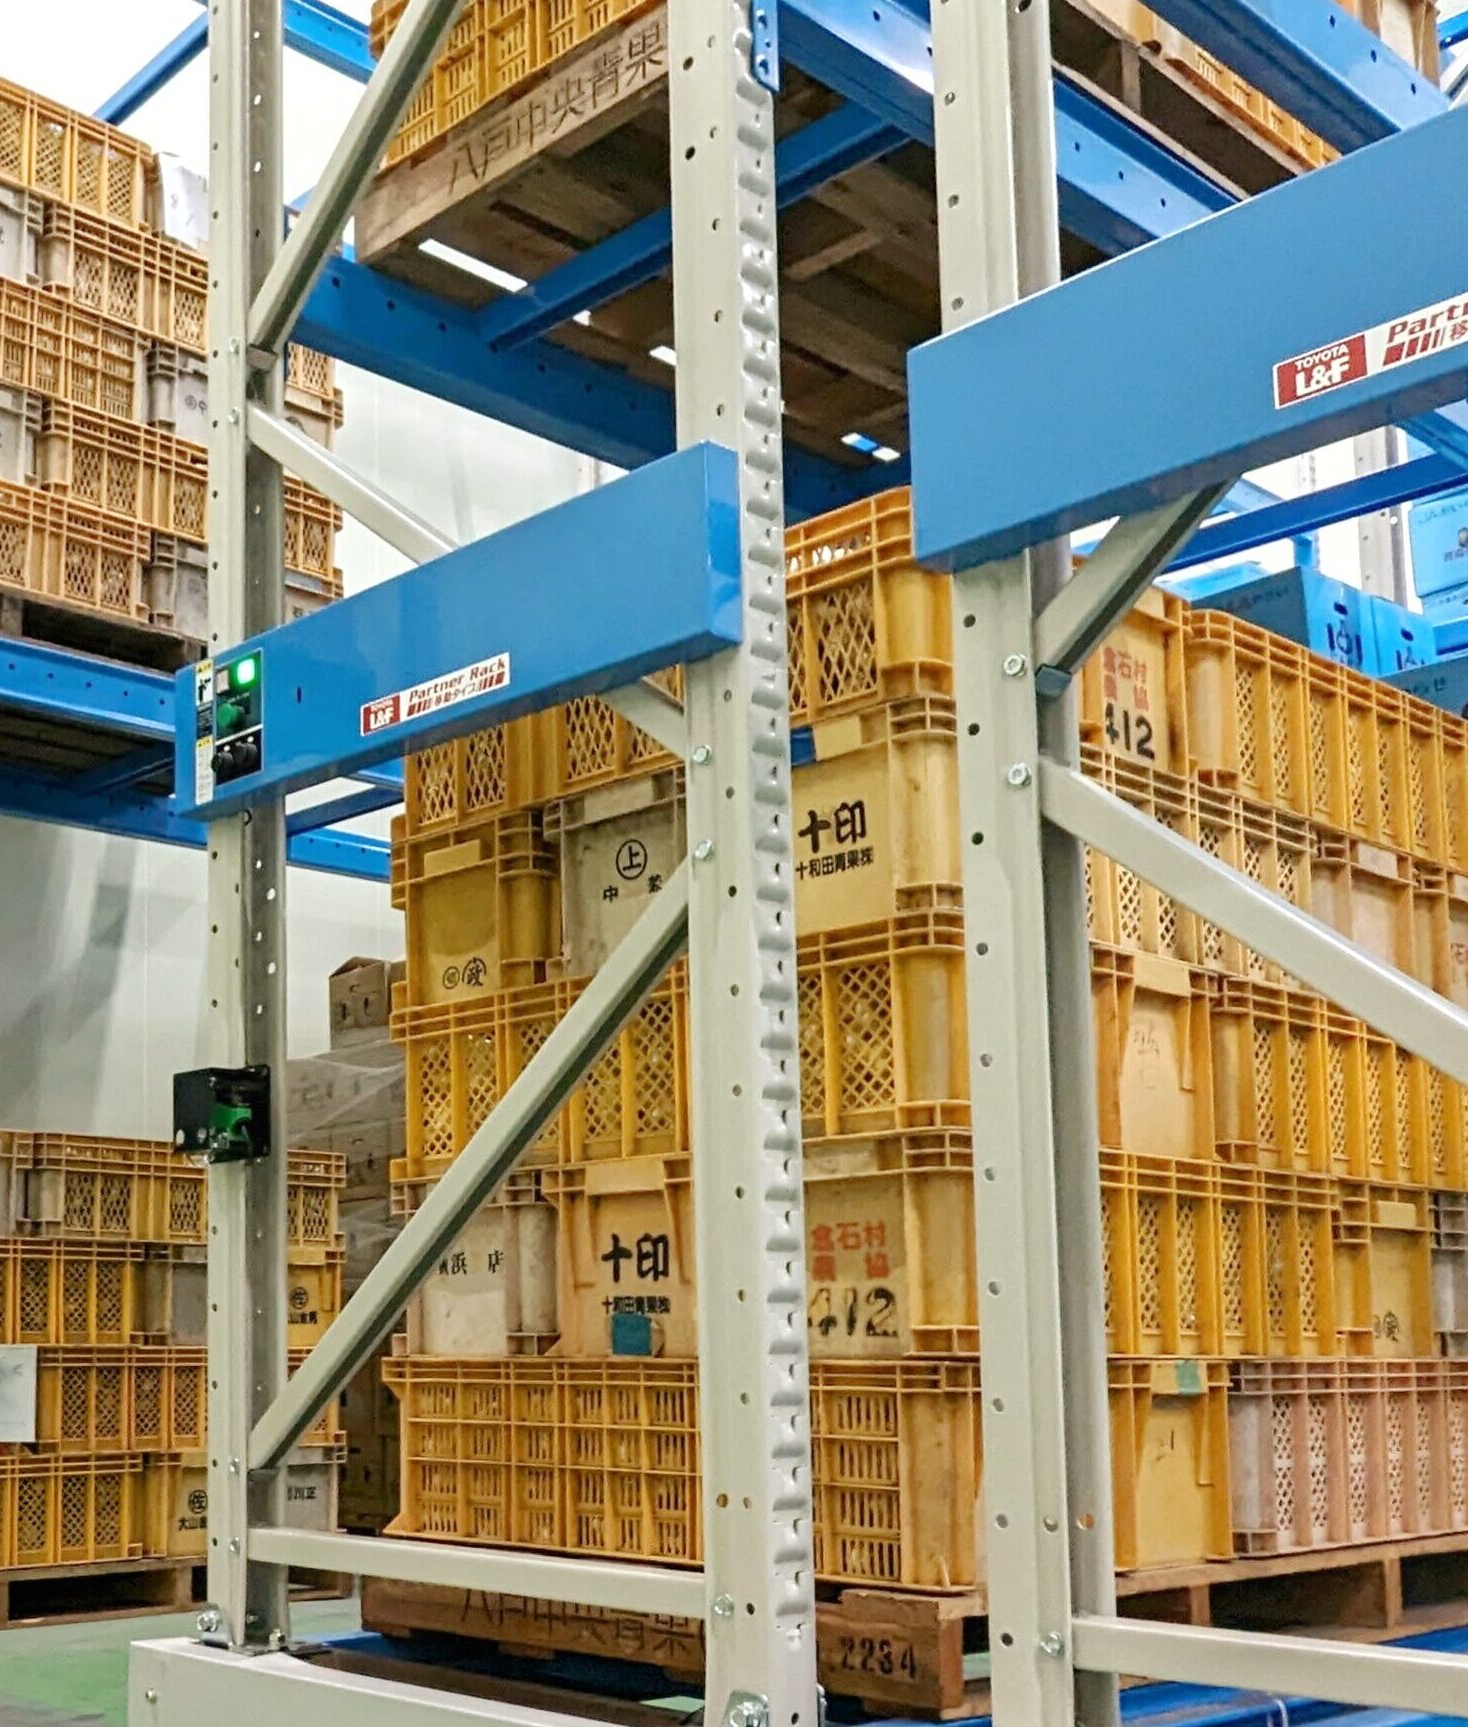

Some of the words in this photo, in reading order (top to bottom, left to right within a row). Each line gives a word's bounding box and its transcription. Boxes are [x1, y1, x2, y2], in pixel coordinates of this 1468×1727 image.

[1294, 343, 1350, 371] TOYOTA
[1295, 356, 1351, 397] L&F
[409, 674, 466, 703] Partner
[470, 657, 506, 682] Rack
[370, 706, 394, 730] L&F
[1105, 702, 1155, 760] 412
[798, 800, 867, 854] 十印
[601, 1232, 670, 1284] 十印
